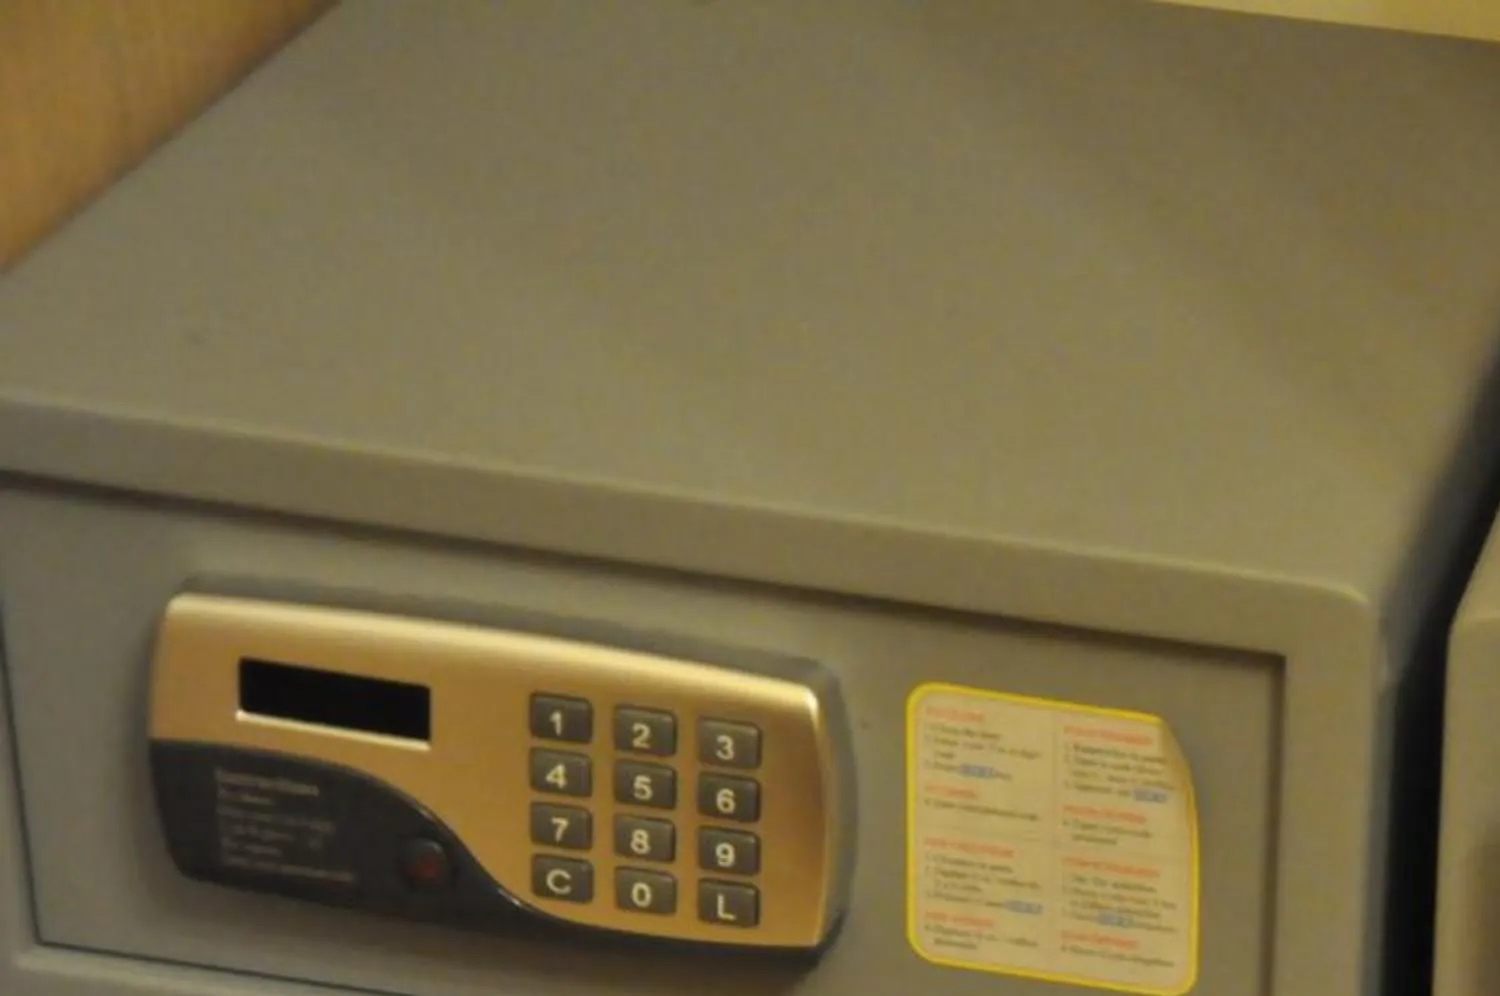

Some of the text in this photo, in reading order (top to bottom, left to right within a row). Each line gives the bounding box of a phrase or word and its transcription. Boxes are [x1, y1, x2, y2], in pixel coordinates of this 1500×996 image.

[549, 710, 735, 761] 1 2 3
[545, 763, 737, 814] 4 5 6
[550, 817, 736, 868] 7 8 9
[545, 869, 737, 921] C 0 L
